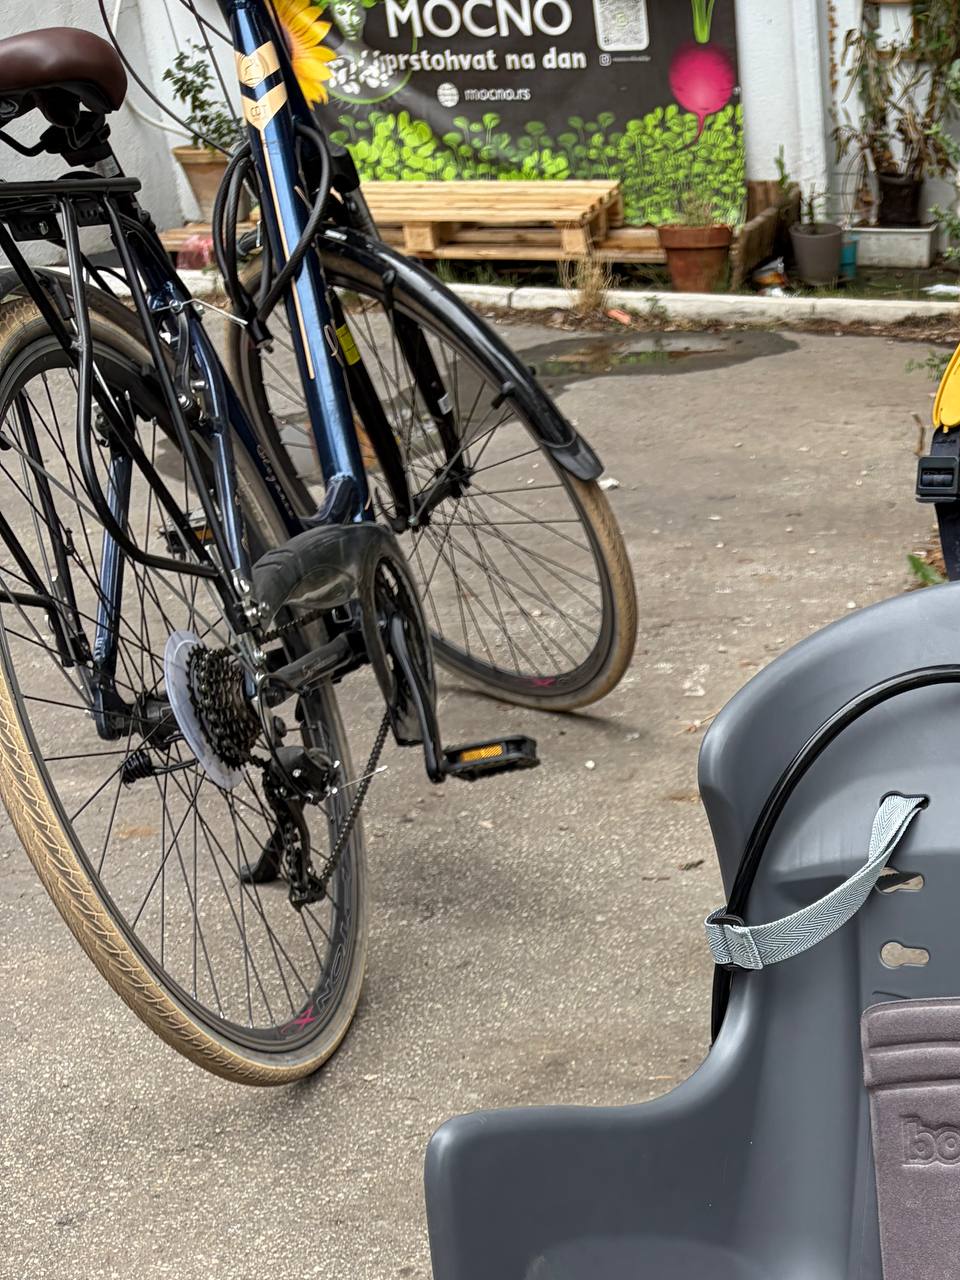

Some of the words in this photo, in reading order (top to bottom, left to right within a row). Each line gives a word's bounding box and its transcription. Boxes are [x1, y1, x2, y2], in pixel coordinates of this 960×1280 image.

[505, 53, 536, 70] na
[542, 46, 587, 70] dan
[463, 87, 531, 101] mocno.rs
